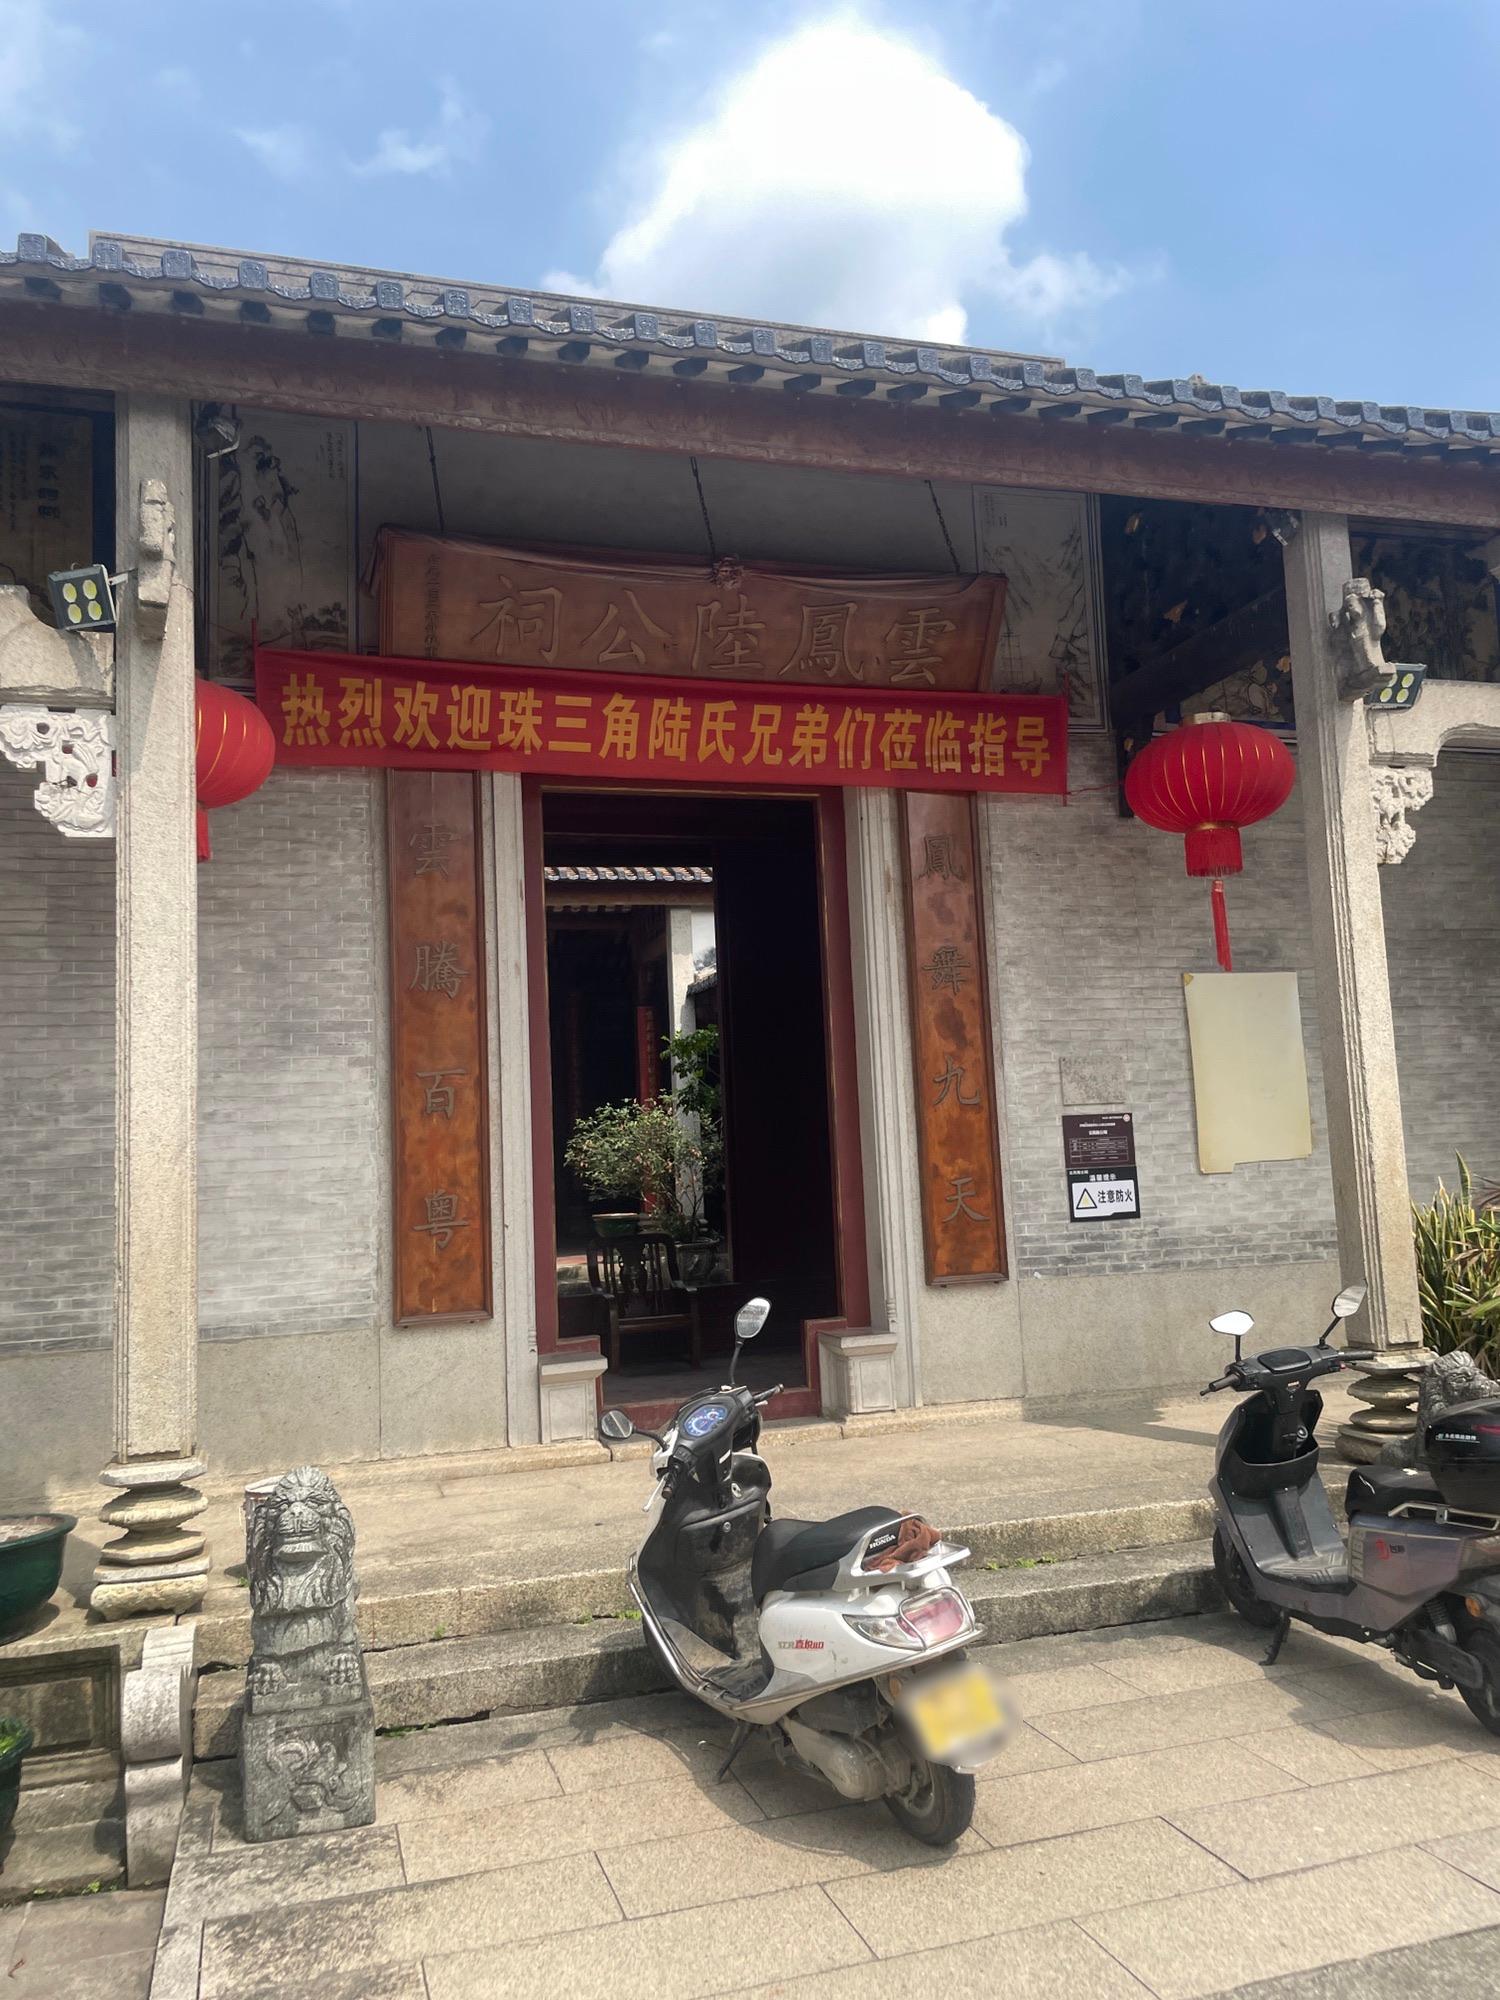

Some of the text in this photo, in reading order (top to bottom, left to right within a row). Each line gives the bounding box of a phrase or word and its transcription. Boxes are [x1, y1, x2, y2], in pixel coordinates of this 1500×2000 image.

[281, 671, 1051, 778] 热烈欢迎珠三角陆氏兄弟们莅临指导
[1097, 1189, 1134, 1204] 注意防火
[869, 1534, 896, 1549] HONDA
